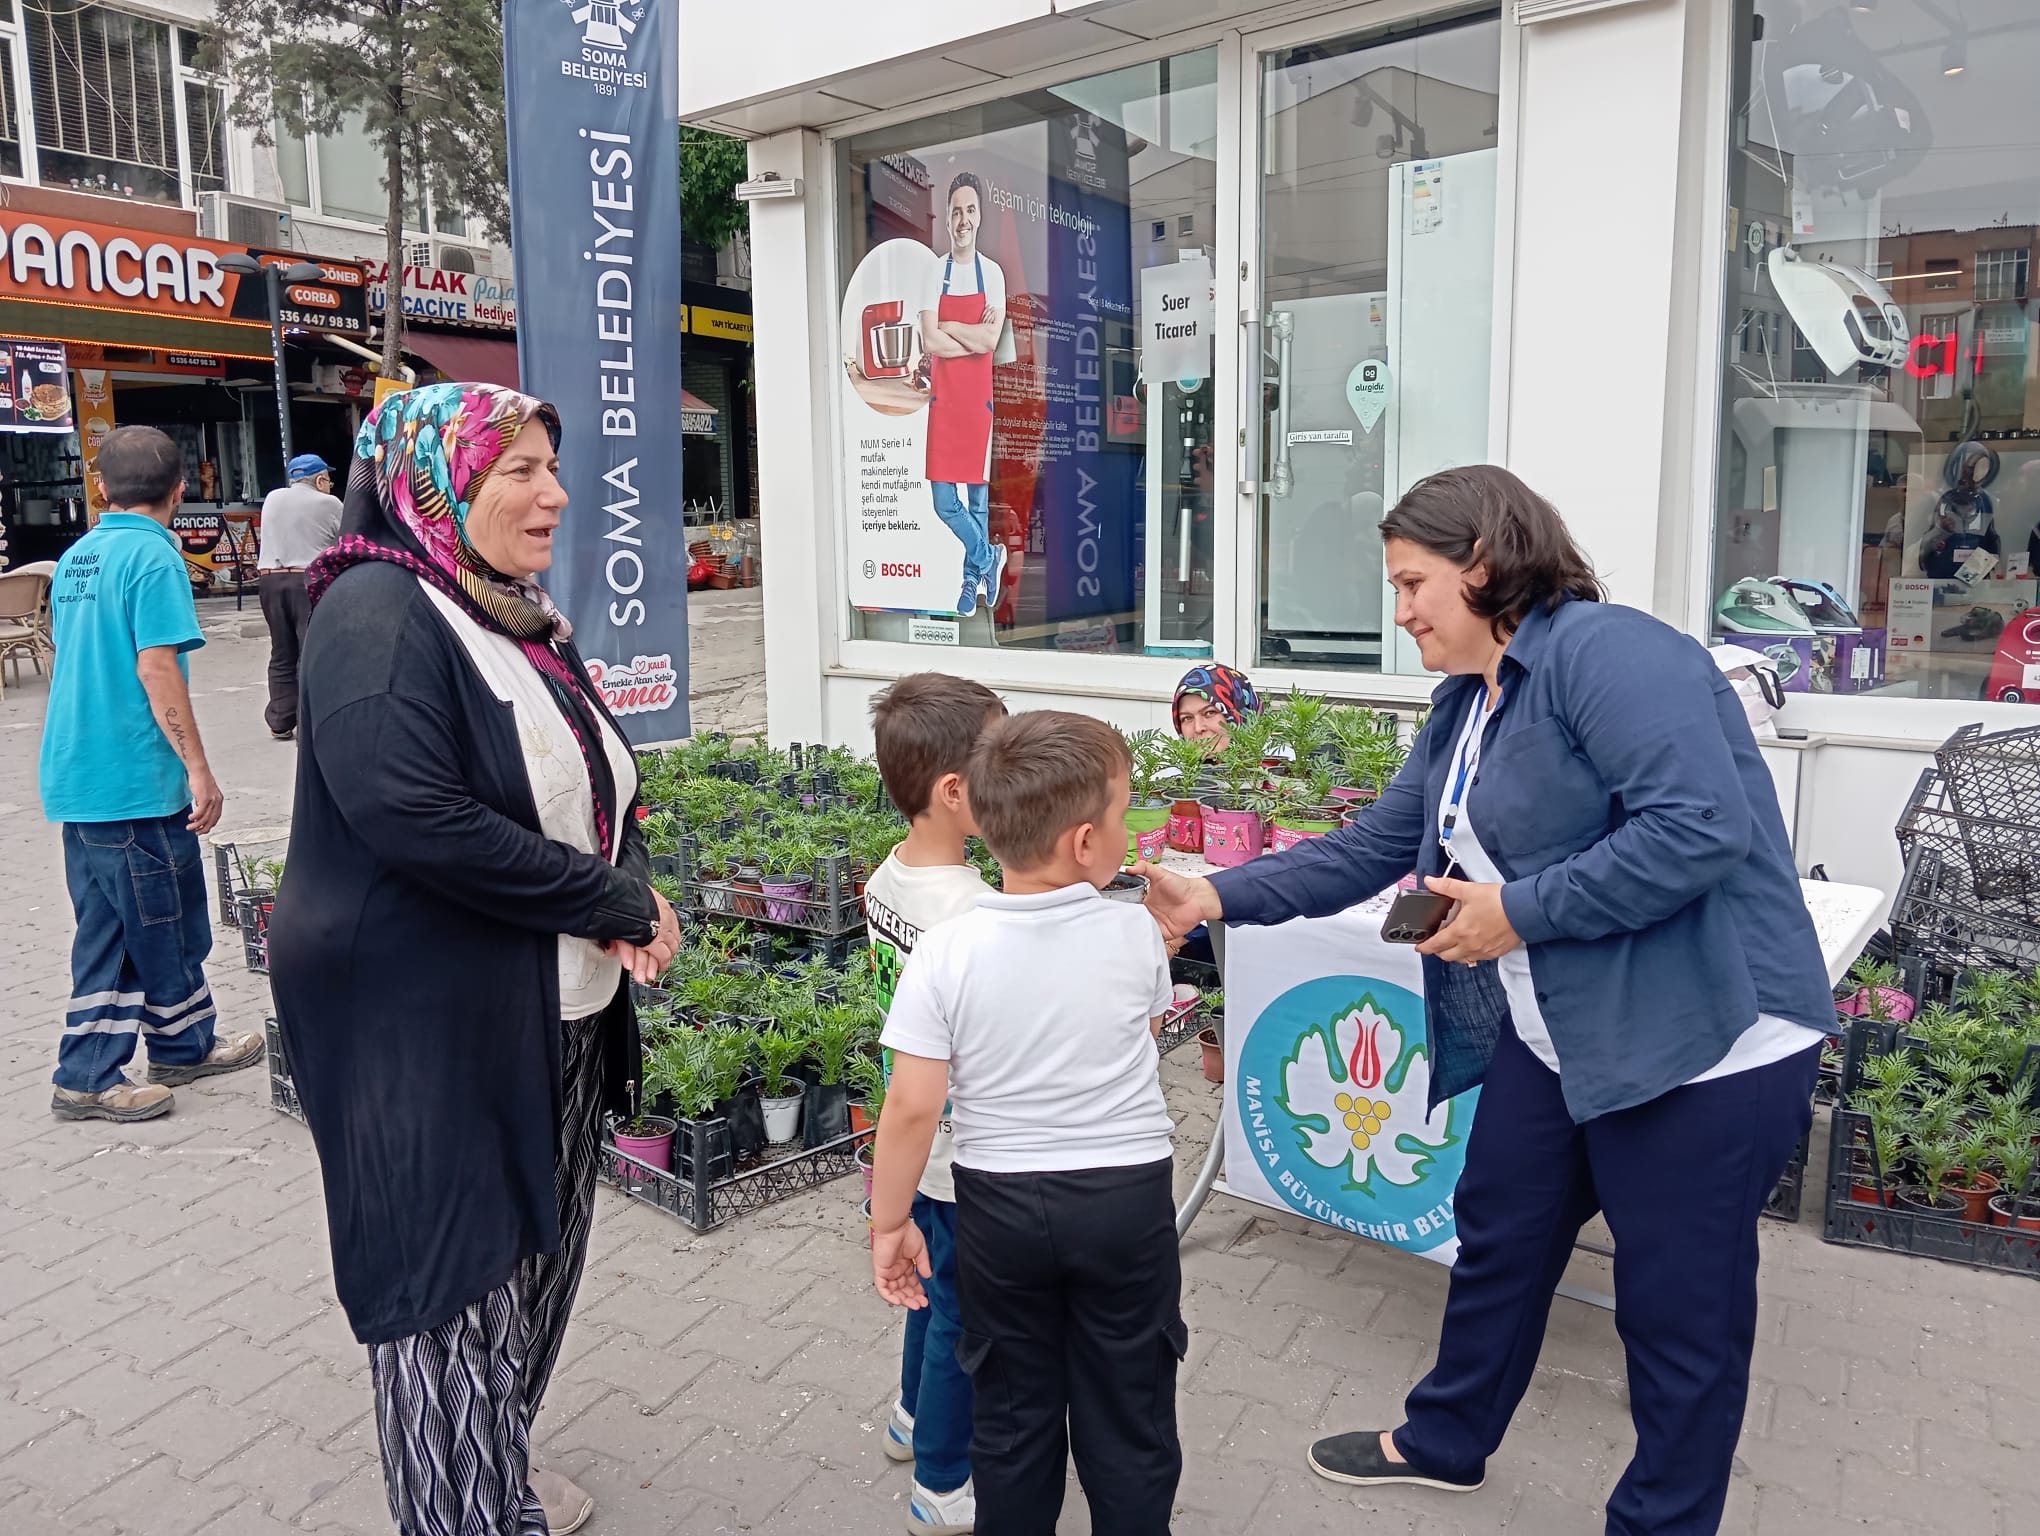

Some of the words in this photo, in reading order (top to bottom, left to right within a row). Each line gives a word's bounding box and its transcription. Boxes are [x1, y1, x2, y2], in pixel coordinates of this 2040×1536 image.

[581, 48, 627, 69] SOMA
[561, 61, 647, 89] BELEDİYESİ
[594, 83, 617, 97] 1891
[986, 179, 1023, 212] Yaşam
[1027, 193, 1046, 222] için
[1049, 203, 1092, 239] teknoloji
[0, 223, 225, 307] ANCAR
[579, 128, 637, 436] BELEDİYESİ
[294, 289, 336, 304] ÇORBA
[367, 288, 467, 319] ÜCACİYE
[1162, 294, 1190, 311] Suer
[303, 313, 325, 326] 447
[329, 316, 343, 328] 98
[345, 318, 359, 329] 38
[1155, 321, 1197, 340] Ticaret
[860, 439, 879, 449] MUM
[881, 438, 901, 449] Serie
[906, 437, 912, 447] 4
[860, 452, 886, 462] mutfak
[861, 466, 909, 478] makineleriyle
[861, 480, 881, 490] kendi
[882, 479, 922, 492] mutfağının
[861, 493, 874, 505] şefi
[876, 493, 898, 503] olmak
[861, 507, 898, 519] isteyenleri
[173, 517, 219, 529] PANCAR
[862, 520, 887, 533] içeriye
[888, 520, 921, 531] bekleriz.
[602, 457, 646, 626] SOMA
[881, 563, 921, 578] BOSCH
[648, 659, 667, 670] KALBİ
[602, 679, 632, 689] Emekle
[634, 676, 653, 686] Atan
[1246, 1075, 1280, 1169] MANİSA
